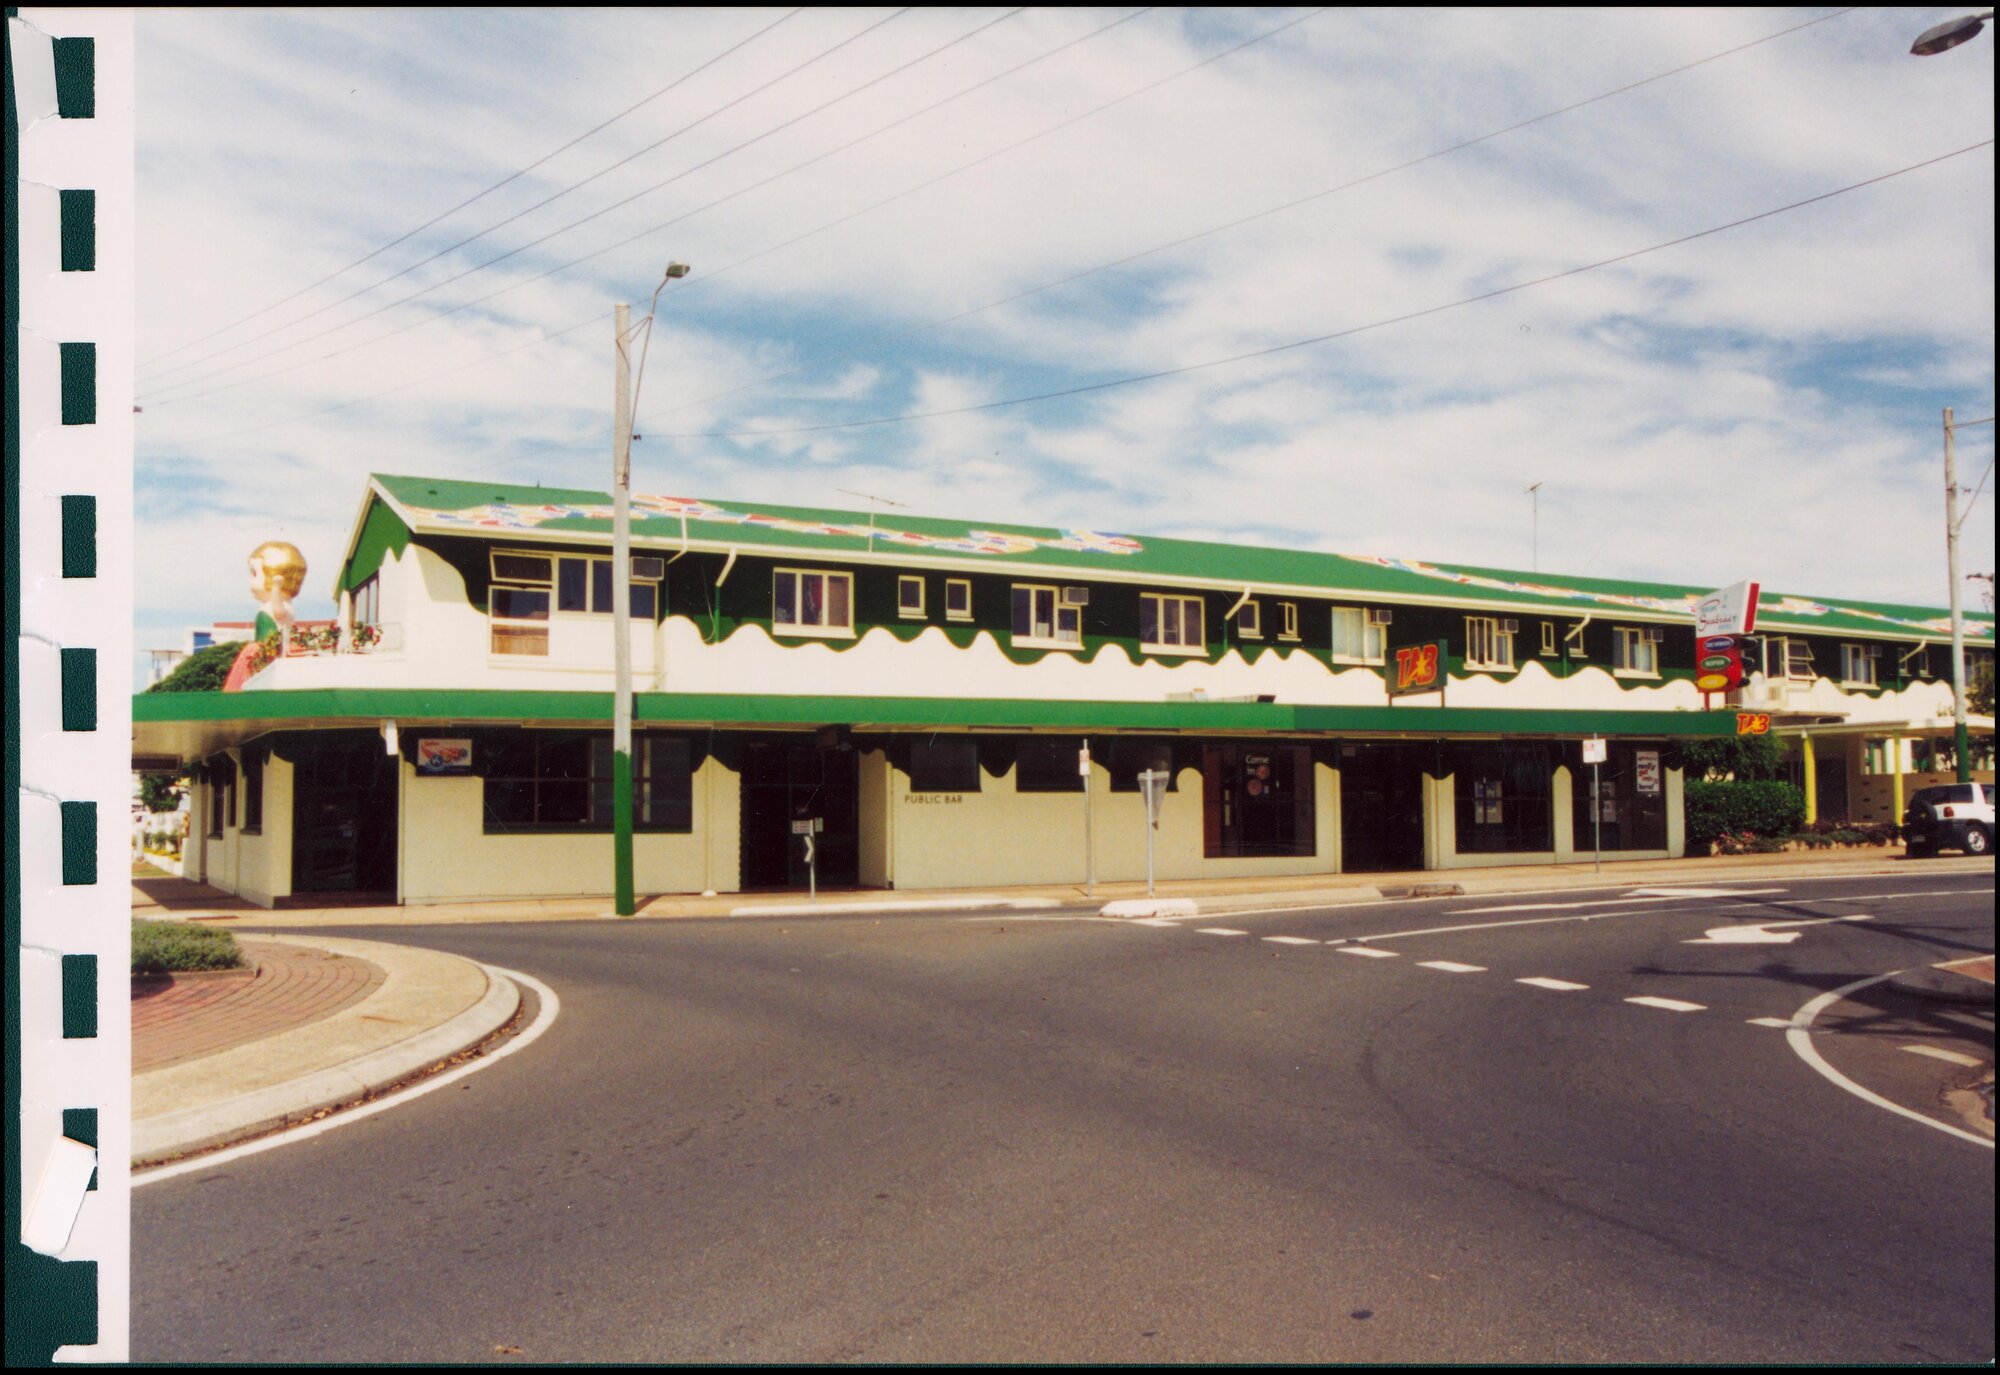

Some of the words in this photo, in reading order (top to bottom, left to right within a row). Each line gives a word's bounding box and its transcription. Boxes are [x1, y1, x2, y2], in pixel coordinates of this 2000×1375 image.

[1396, 644, 1438, 688] TAB
[1736, 713, 1770, 735] TAB
[1245, 755, 1270, 764] Come
[904, 795, 941, 804] PUBLIC
[944, 795, 963, 804] BAR
